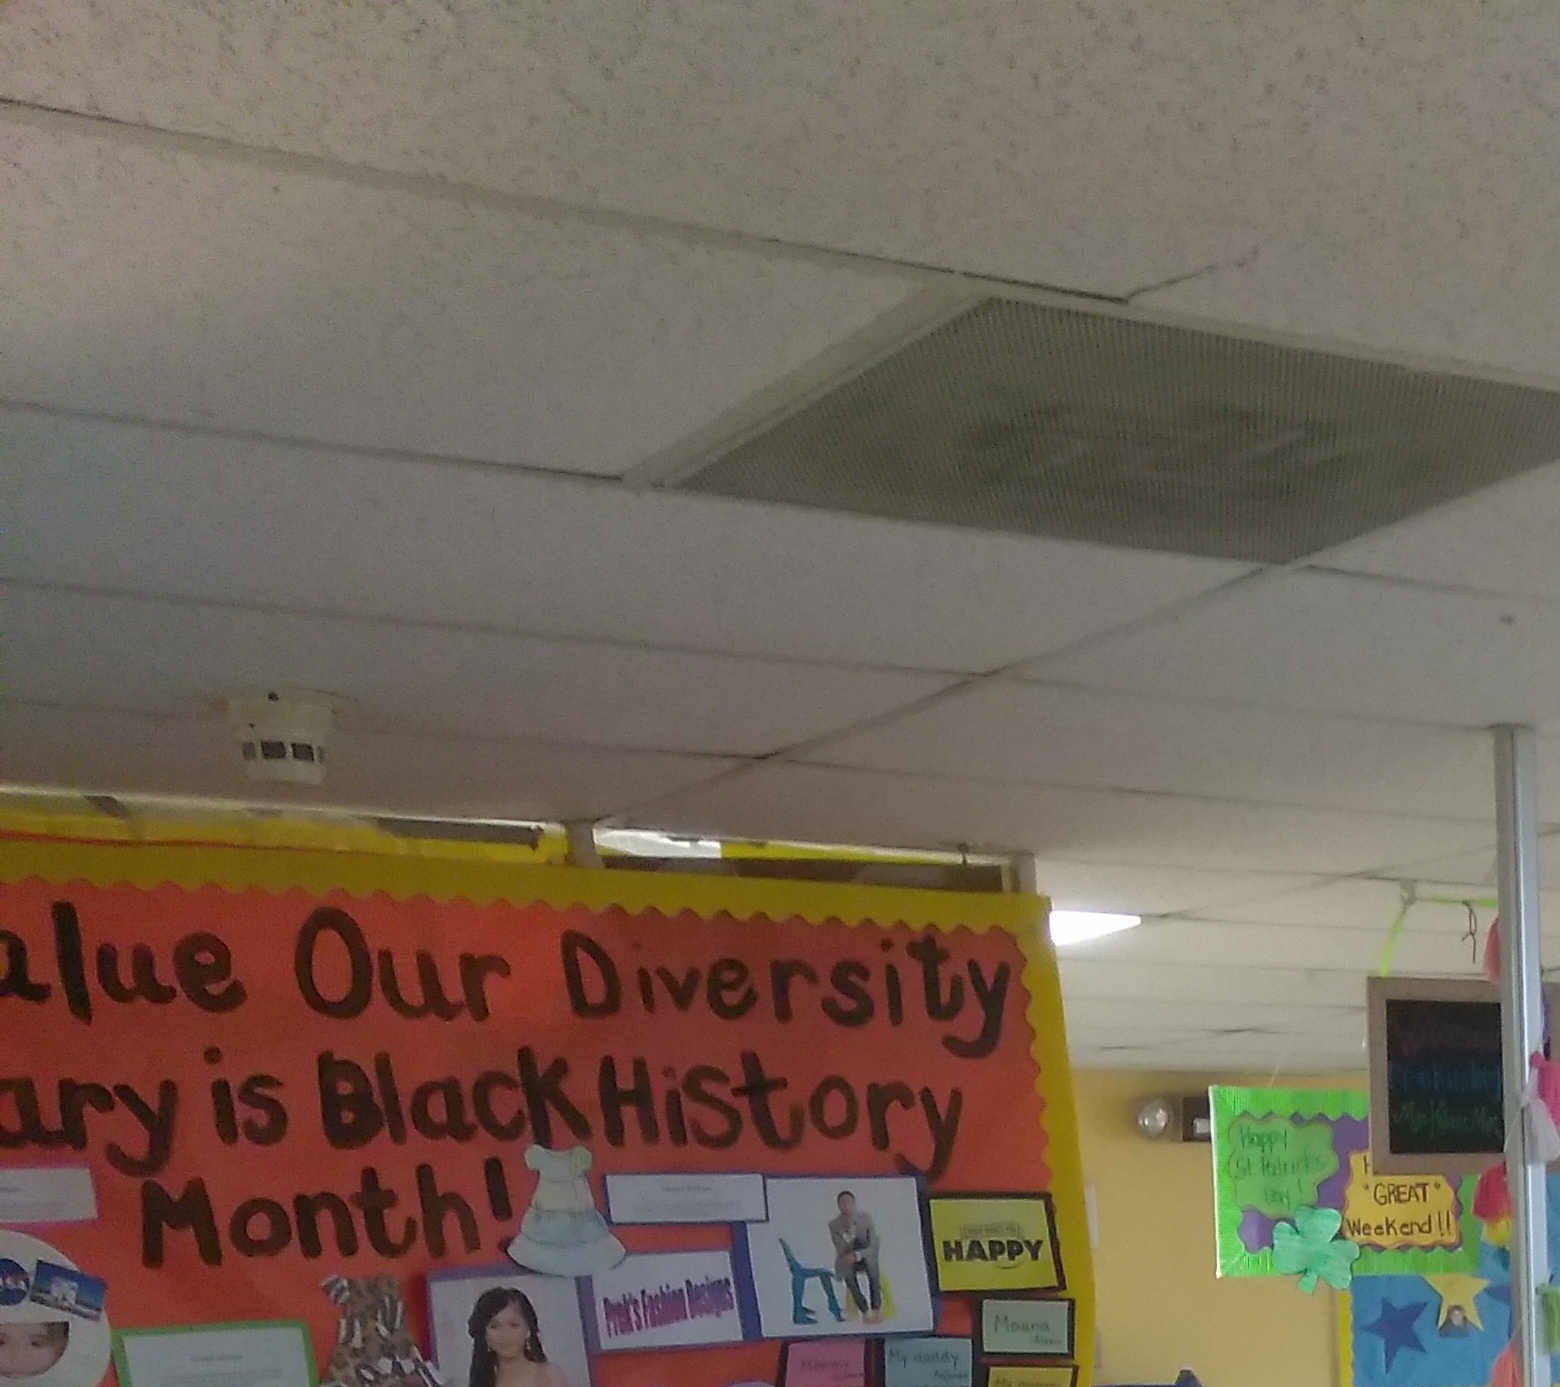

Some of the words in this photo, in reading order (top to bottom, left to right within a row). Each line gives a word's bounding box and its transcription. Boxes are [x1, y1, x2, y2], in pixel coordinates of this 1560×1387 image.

[295, 906, 511, 1022] Our
[561, 929, 1010, 1058] Diversity
[204, 1046, 288, 1146] is
[142, 1157, 513, 1268] Month!
[942, 1239, 1044, 1262] HAPPY
[994, 1314, 1050, 1335] Moana
